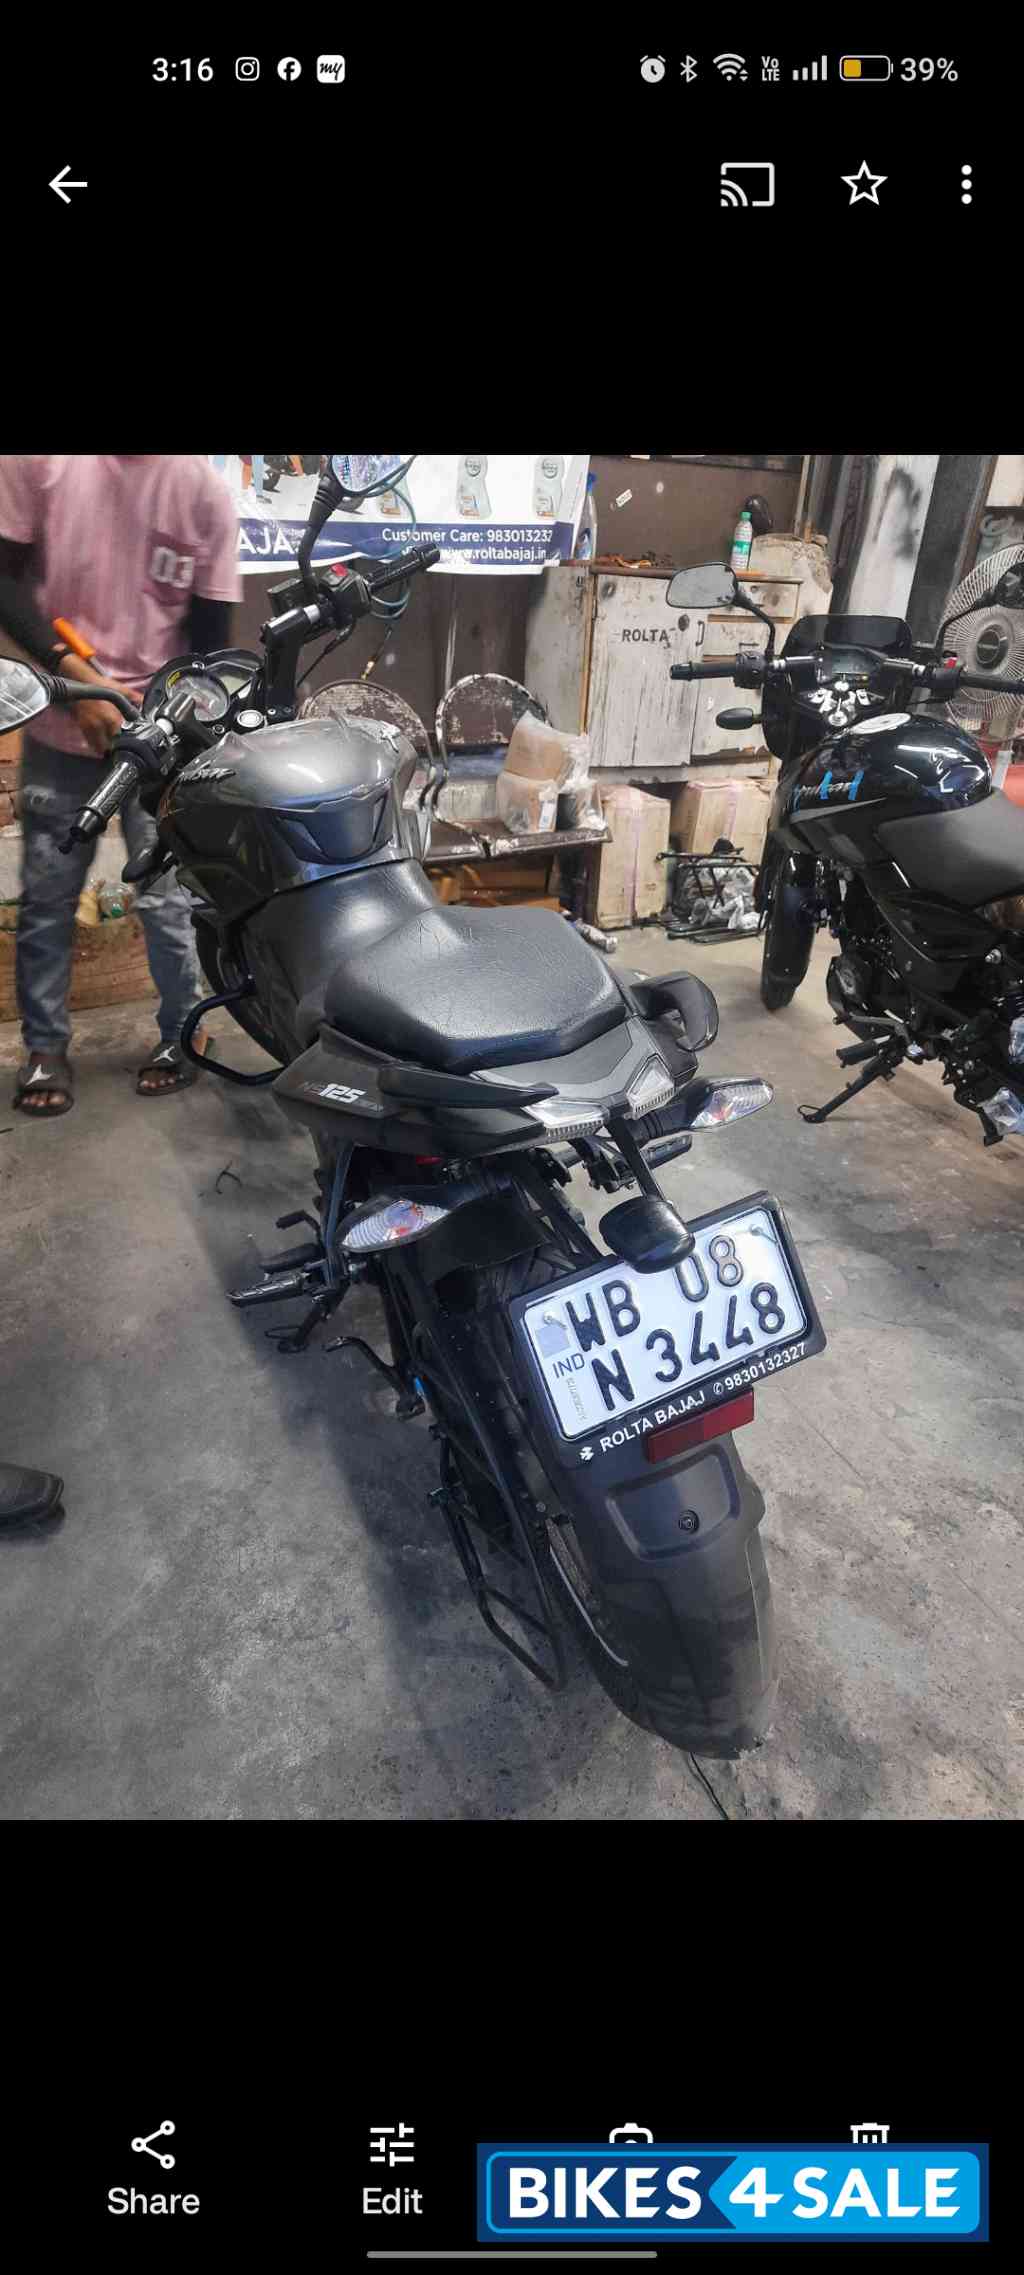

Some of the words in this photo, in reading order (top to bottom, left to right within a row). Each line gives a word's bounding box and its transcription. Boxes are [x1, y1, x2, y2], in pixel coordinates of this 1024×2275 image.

[382, 528, 446, 542] Customer
[450, 529, 483, 542] Care:
[622, 628, 669, 642] ROLTA
[565, 1280, 641, 1352] WB
[673, 1234, 744, 1303] 08
[552, 1353, 586, 1379] IND
[591, 1349, 635, 1411] N
[645, 1282, 785, 1383] 3448
[600, 1417, 654, 1453] ROLTA
[655, 1390, 705, 1425] BAJAJ
[724, 1342, 806, 1391] 9830132327
